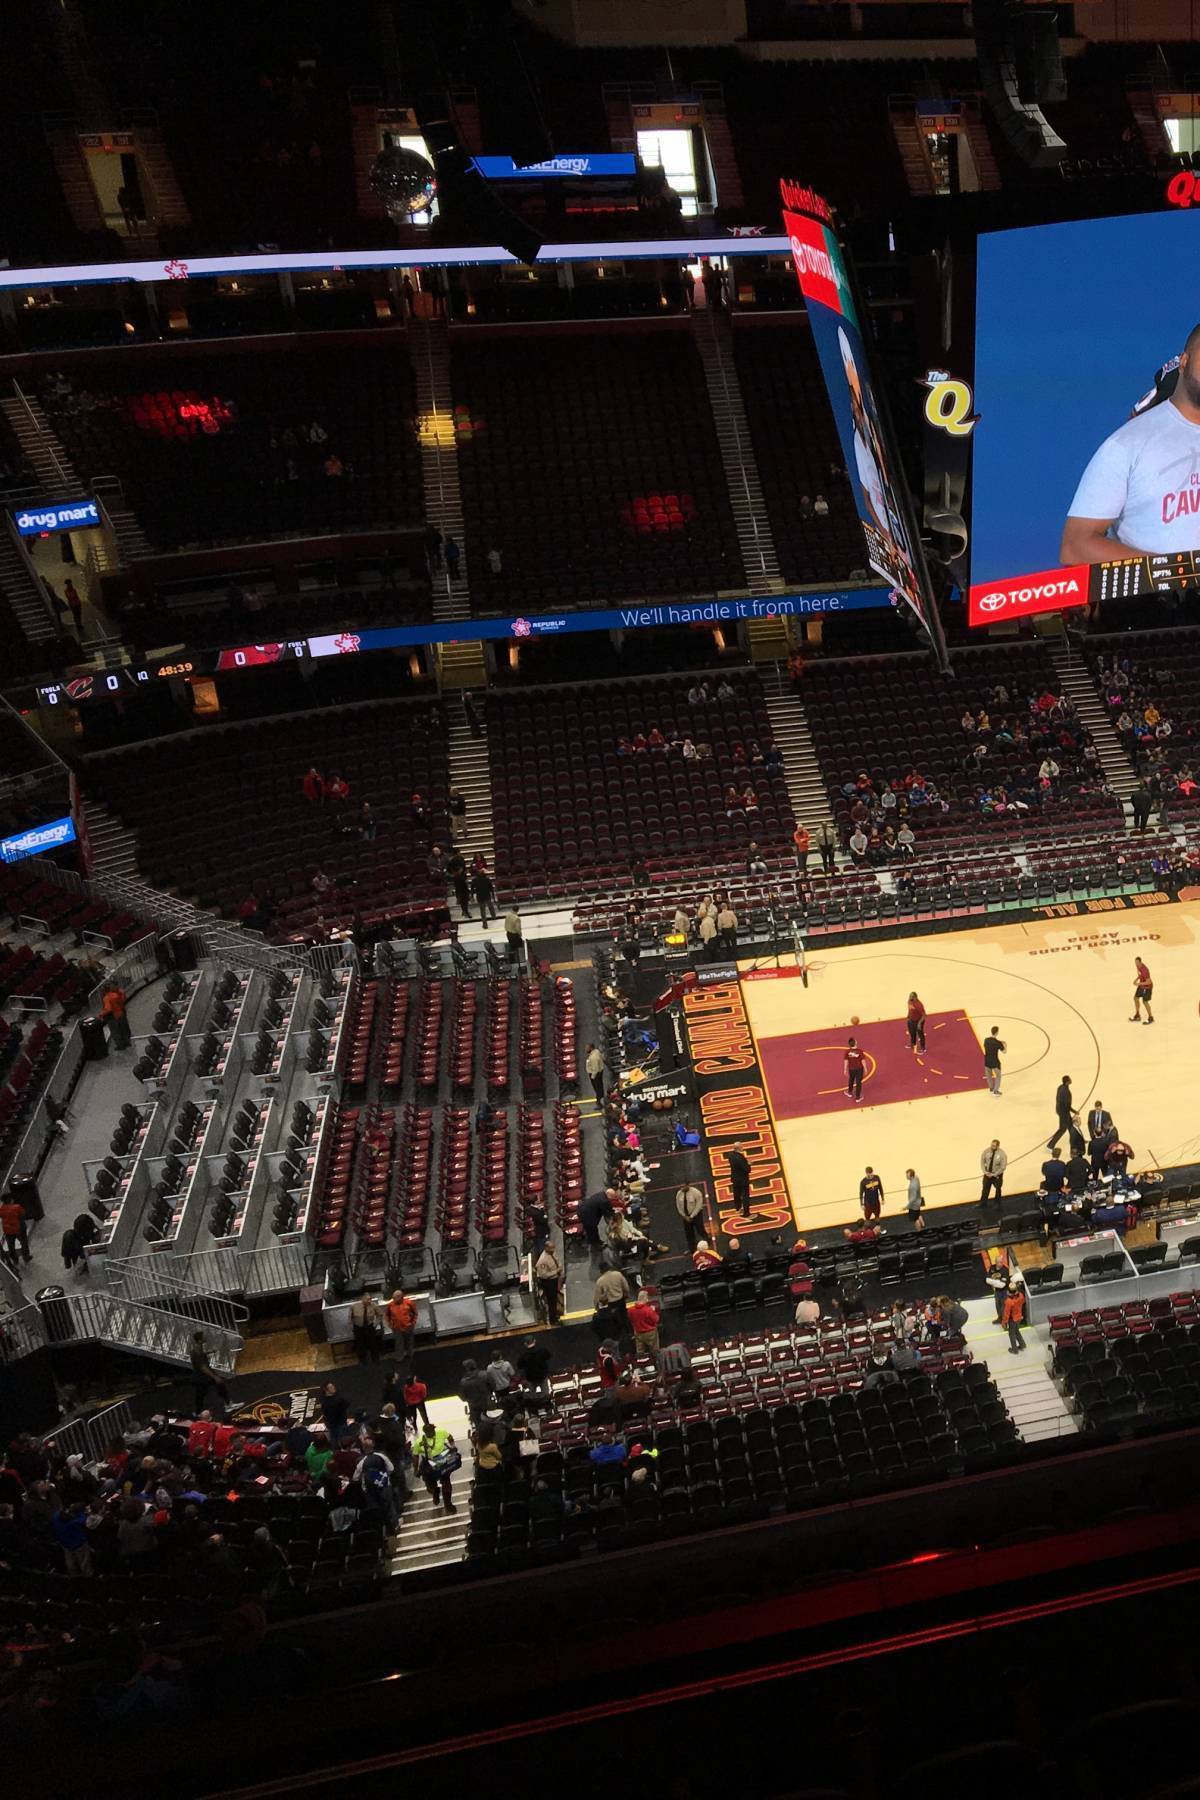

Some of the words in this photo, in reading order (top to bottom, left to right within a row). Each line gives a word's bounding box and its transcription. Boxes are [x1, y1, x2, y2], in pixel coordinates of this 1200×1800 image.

[926, 381, 976, 434] Q
[18, 513, 58, 528] drug
[58, 504, 98, 522] mart
[1152, 556, 1168, 565] FG%
[1008, 580, 1079, 604] TOYOTA
[621, 606, 664, 626] We'll
[669, 602, 731, 623] handle
[735, 602, 748, 618] it
[751, 599, 795, 616] from
[799, 595, 845, 612] here.
[532, 620, 566, 629] REPUBLIC
[235, 651, 246, 665] 0
[295, 647, 303, 658] 0
[158, 662, 194, 677] 48:39
[106, 676, 119, 690] 0
[49, 693, 58, 704] 0
[1089, 897, 1126, 912] FOR
[1130, 892, 1170, 905] ONE
[1032, 903, 1079, 918] ALL.
[1067, 932, 1120, 944] Arena
[1090, 932, 1161, 949] Quicken
[1028, 944, 1082, 956] Loans
[626, 1091, 656, 1103] drug
[656, 1085, 686, 1098] mart
[700, 1086, 792, 1236] CLEVELAND
